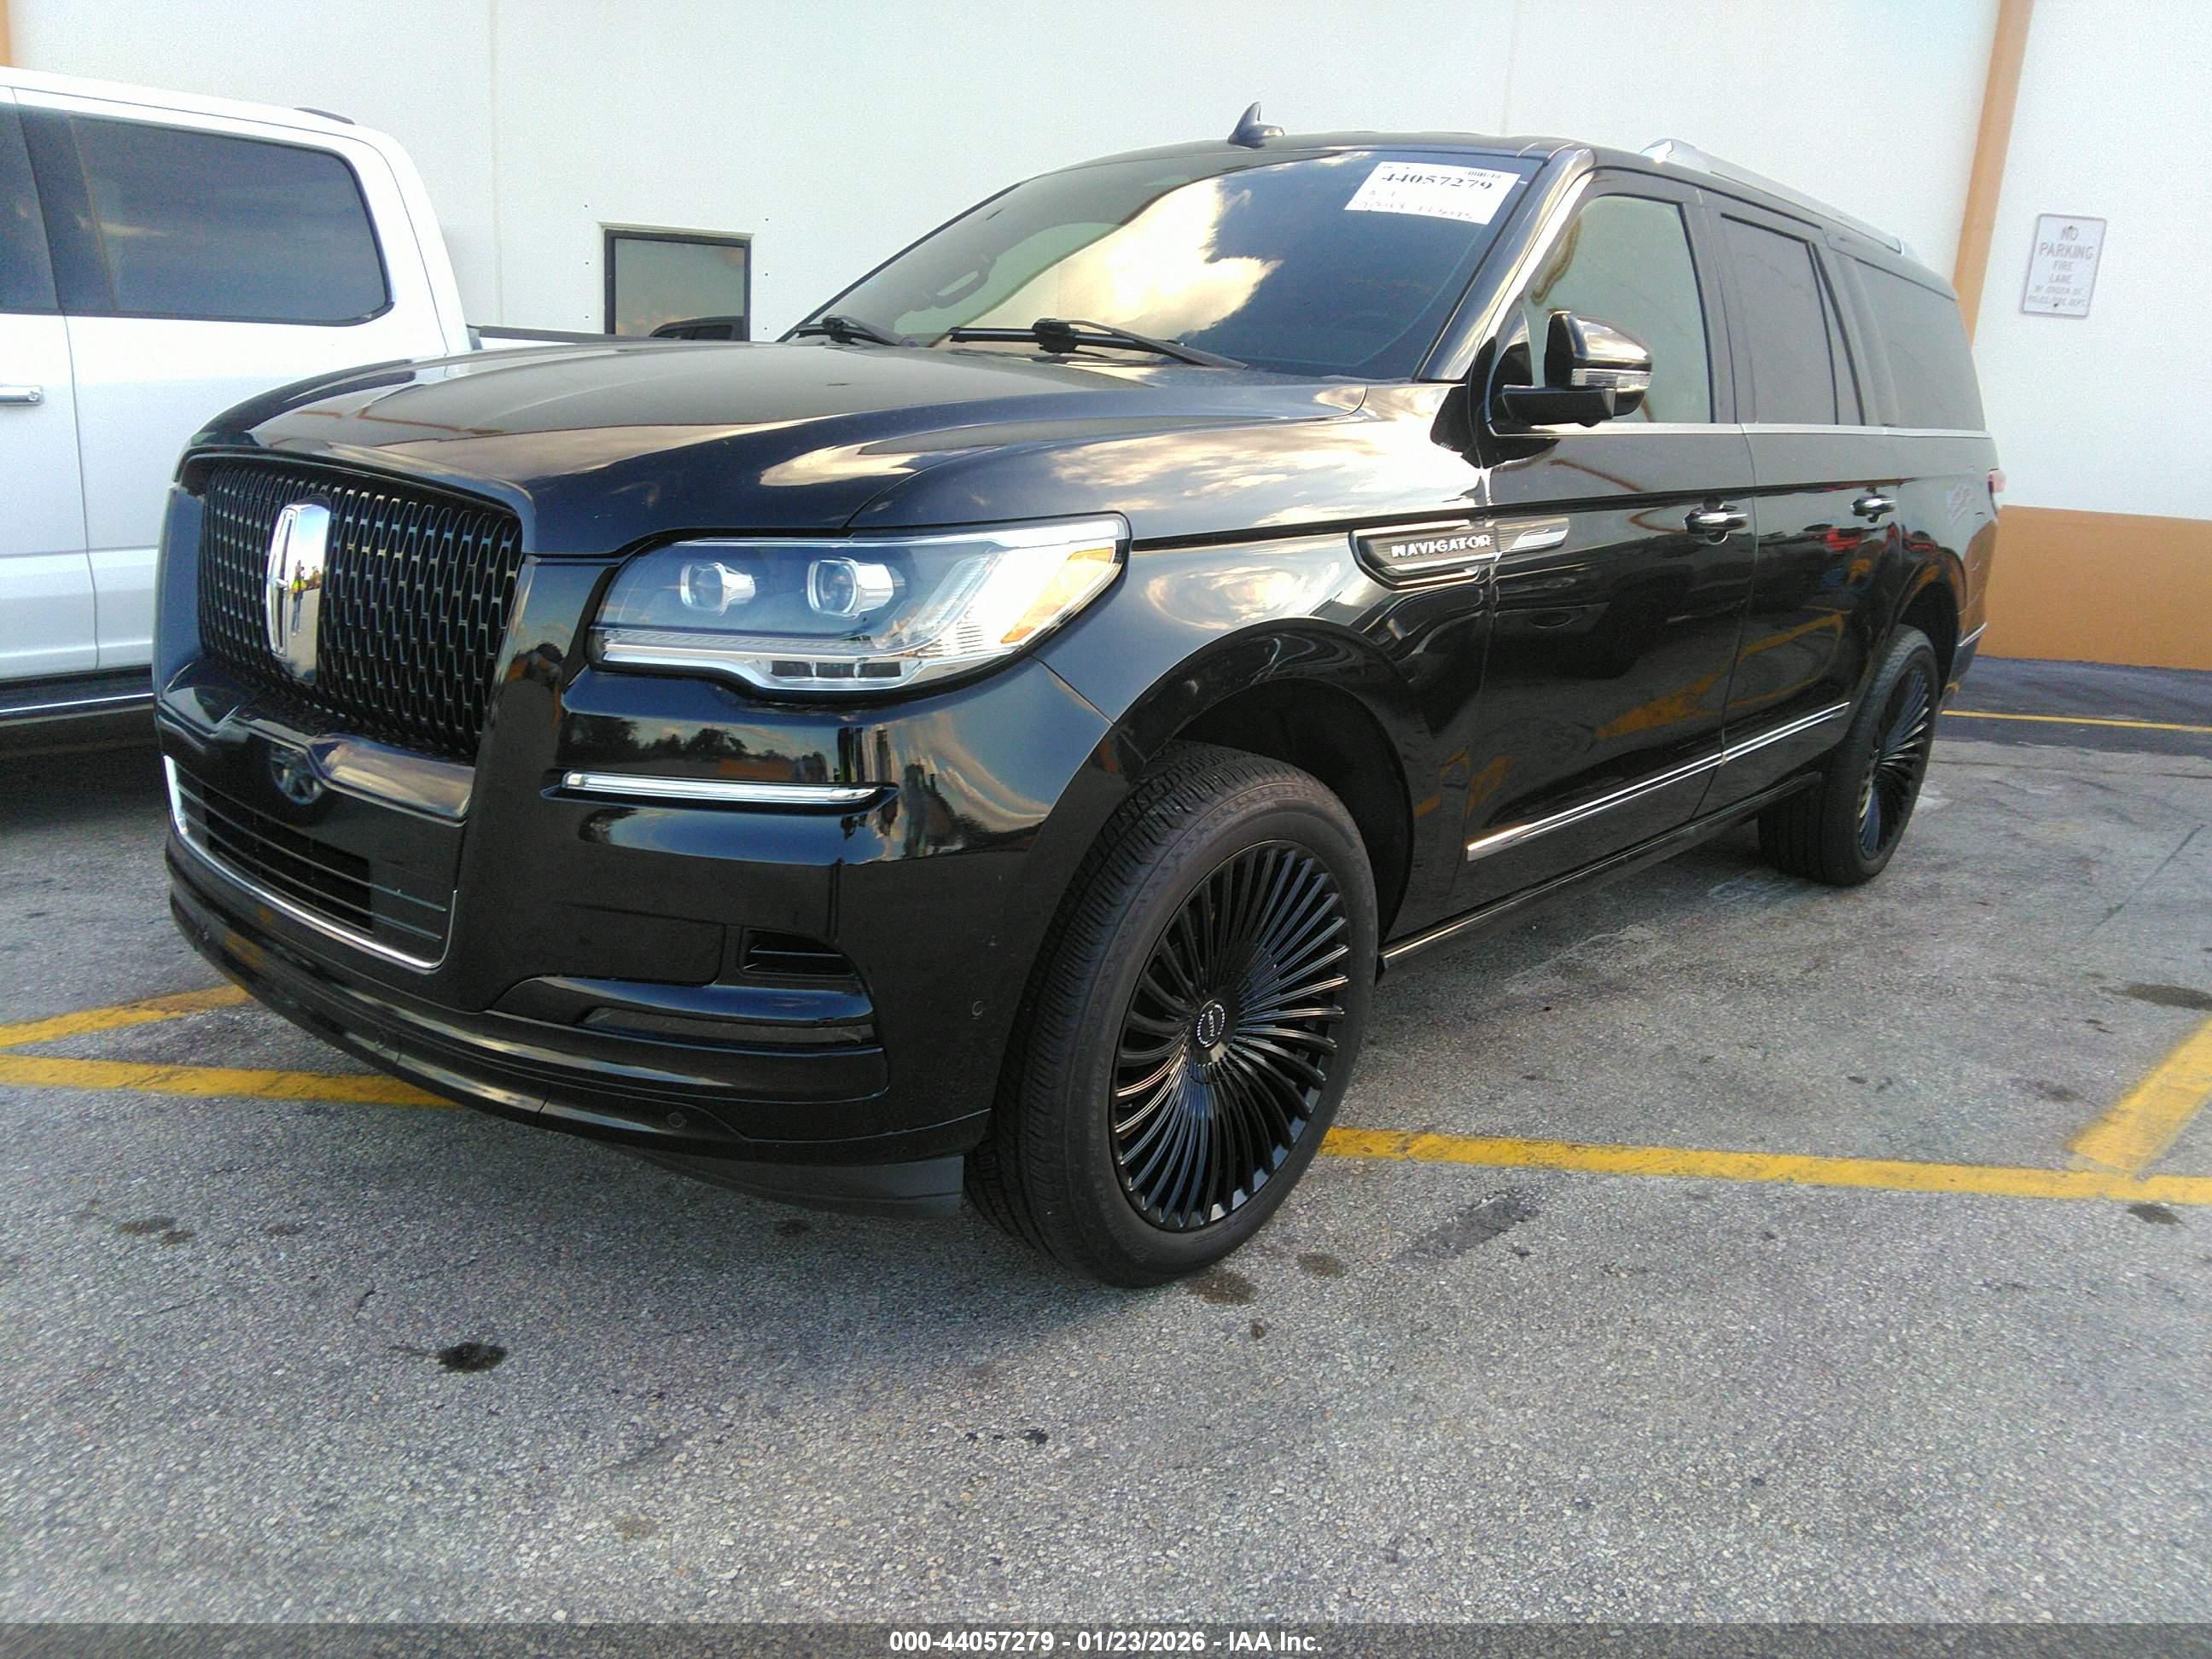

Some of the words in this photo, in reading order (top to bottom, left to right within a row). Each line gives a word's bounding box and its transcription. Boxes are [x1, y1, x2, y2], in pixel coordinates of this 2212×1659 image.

[1382, 173, 1493, 189] 44057279
[2061, 227, 2079, 241] NO
[2040, 242, 2093, 259] PARKING
[2053, 260, 2075, 271] FIRE
[2049, 273, 2072, 284] LANE
[1391, 534, 1492, 558] NAVIGATOR
